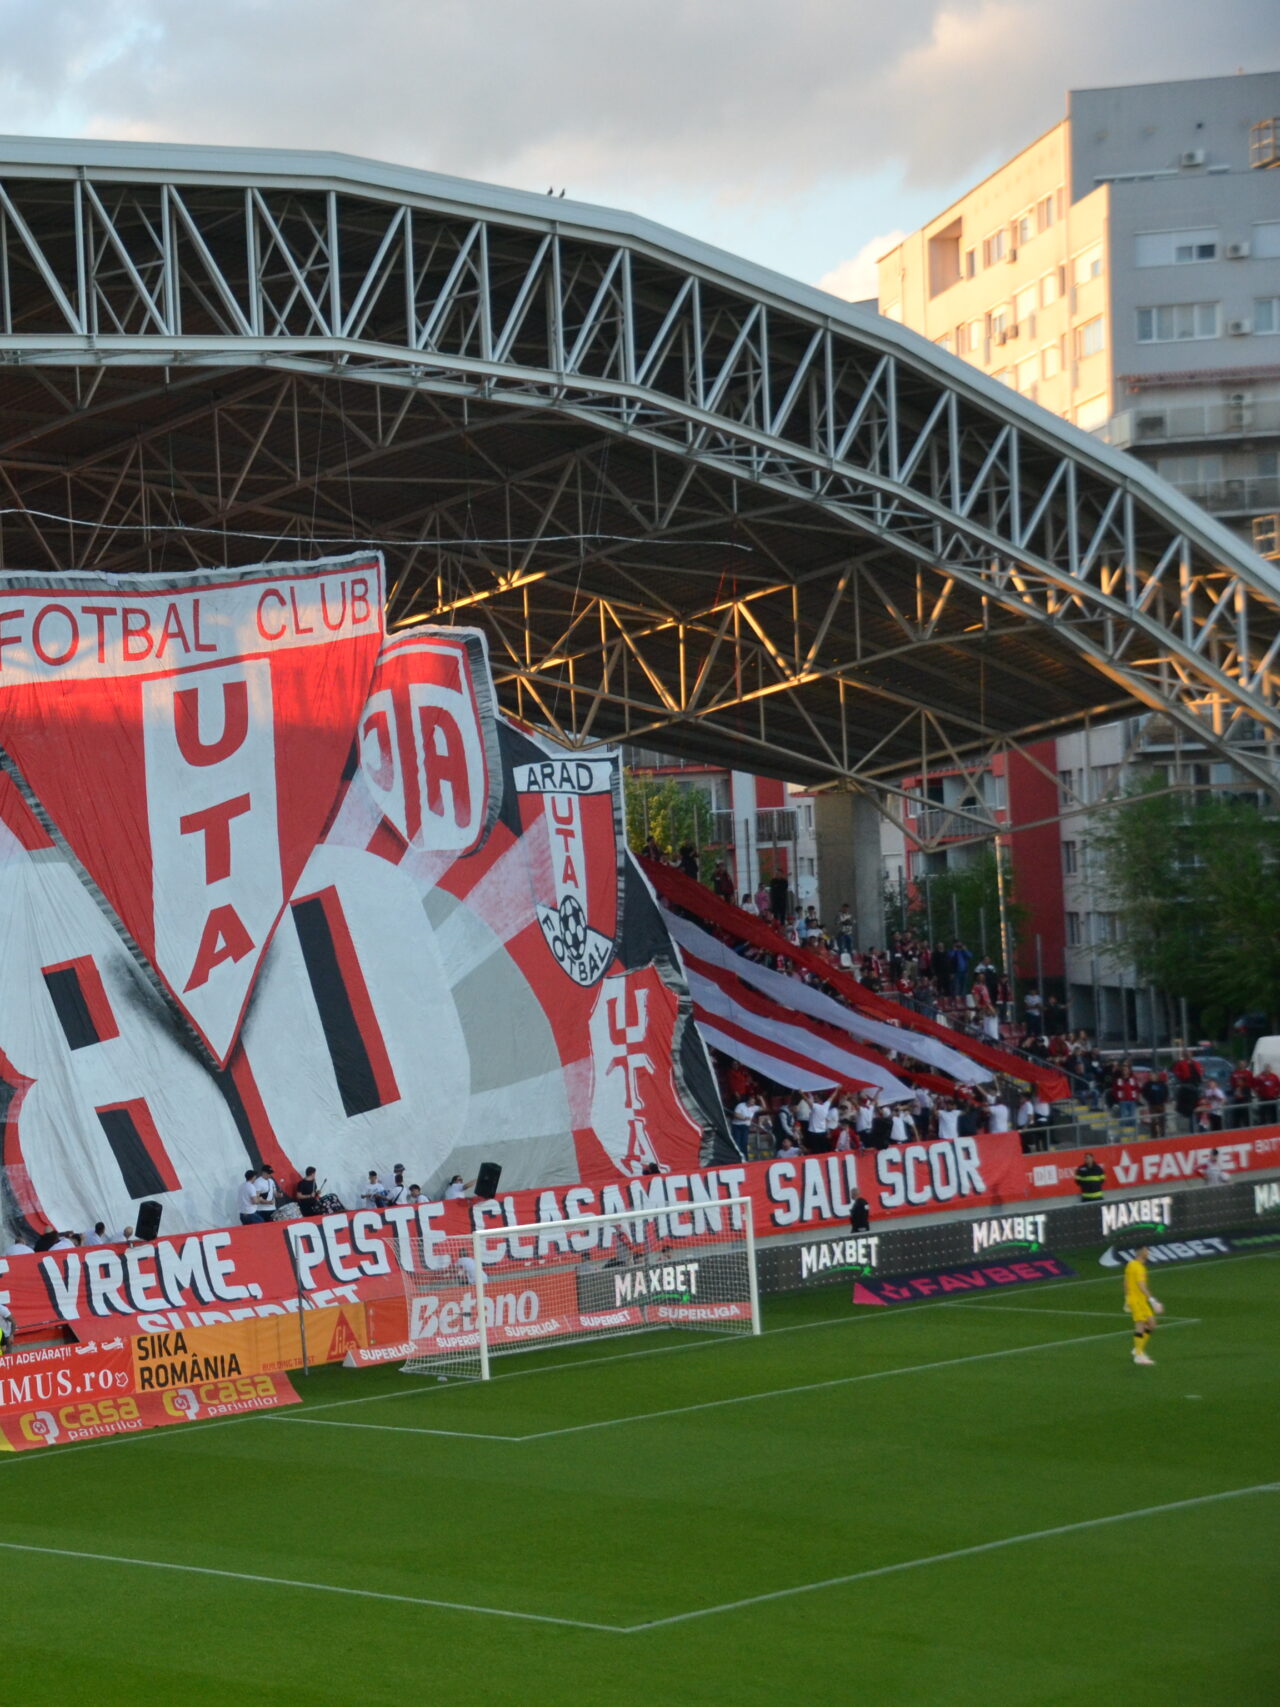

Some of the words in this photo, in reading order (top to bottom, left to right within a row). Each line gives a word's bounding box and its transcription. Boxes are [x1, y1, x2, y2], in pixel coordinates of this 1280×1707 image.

[256, 578, 372, 642] CLUB
[526, 761, 594, 792] ARAD
[173, 680, 256, 994] UTA
[551, 796, 579, 889] UTA
[542, 913, 609, 982] FOTBAL
[39, 1231, 263, 1321] VREME,
[286, 1202, 451, 1291] PESTE
[470, 1168, 746, 1265] CLASAMENT
[766, 1153, 858, 1227] SAU
[877, 1136, 986, 1208] SCOR
[972, 1214, 1046, 1254] MAXBET
[1101, 1196, 1172, 1236] MAXBET
[801, 1236, 880, 1279] MAXBET
[614, 1263, 699, 1307] MAXBET
[908, 1259, 1064, 1297] FAVBET
[411, 1290, 539, 1340] Betano
[658, 1305, 741, 1320] SUPERLIGA
[137, 1332, 188, 1361] SIKA
[360, 1342, 419, 1361] SUPERLIGA
[436, 1332, 484, 1348] SUPERBE
[504, 1319, 561, 1337] SUPERLIGA
[580, 1311, 631, 1327] SUPERBET
[140, 1353, 242, 1390] ROMÂNIA
[200, 1375, 276, 1405] casa
[59, 1396, 140, 1429] casa
[208, 1397, 278, 1417] pariurilor
[67, 1418, 143, 1441] pariurilor
